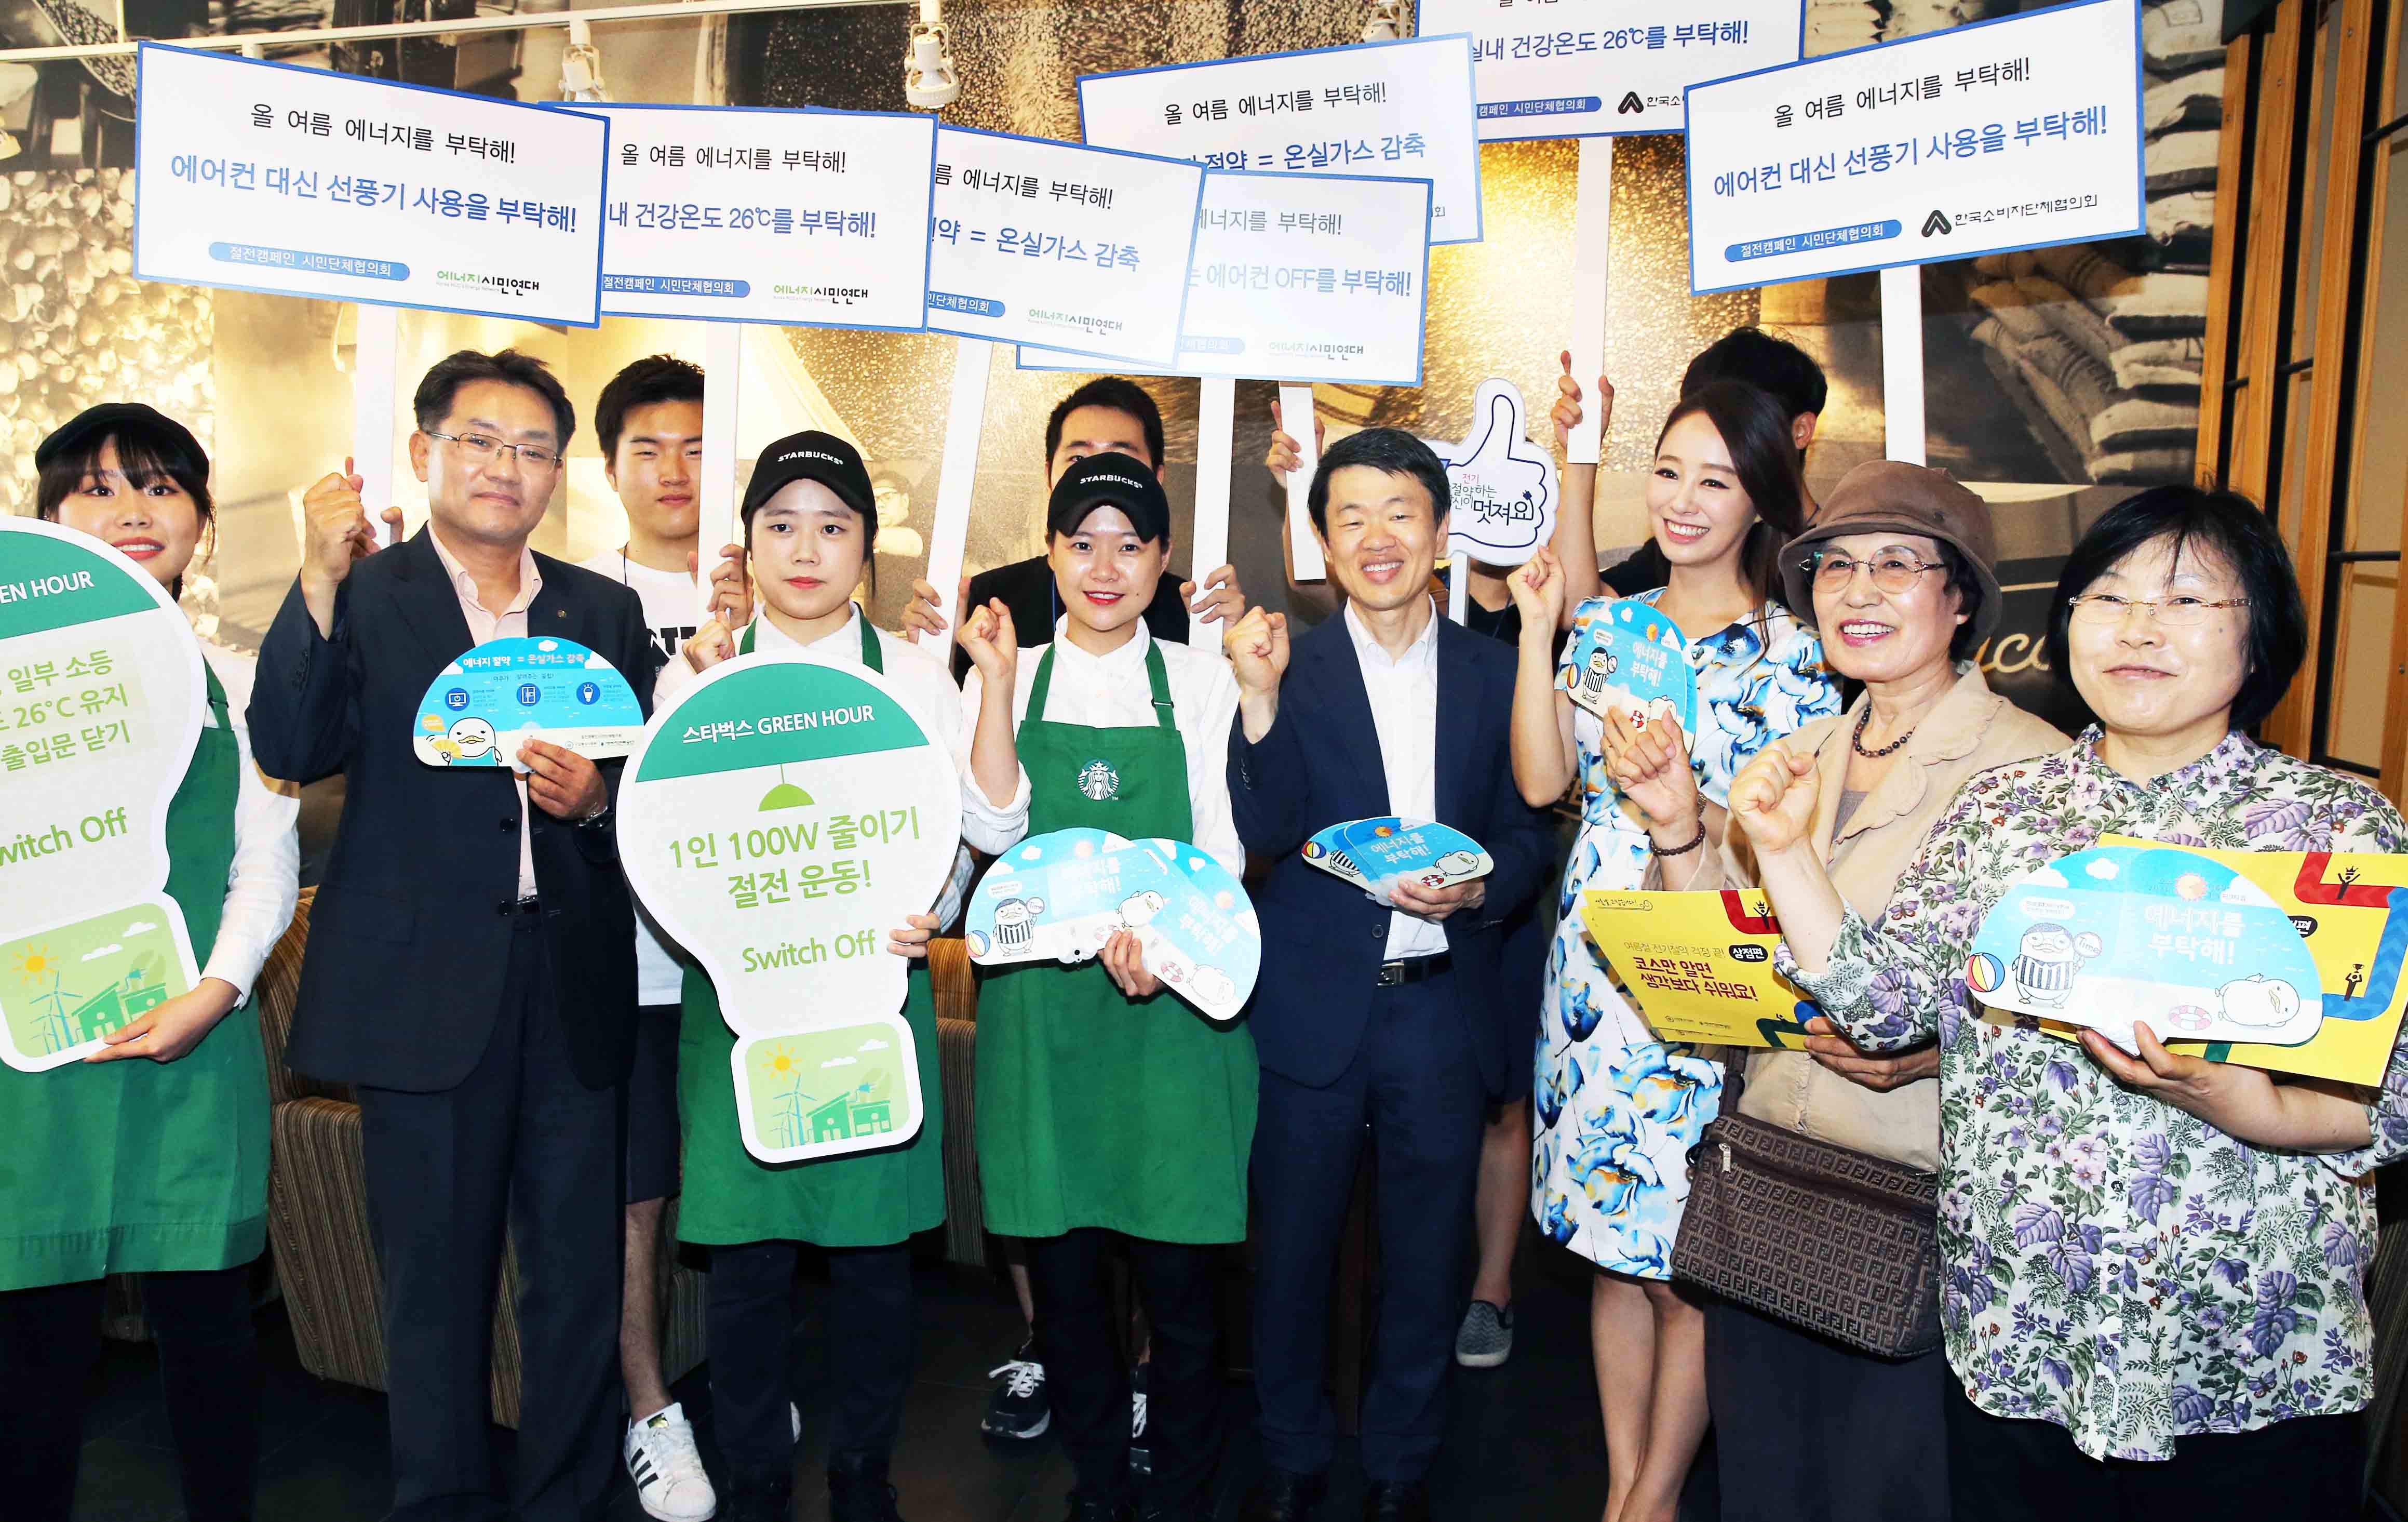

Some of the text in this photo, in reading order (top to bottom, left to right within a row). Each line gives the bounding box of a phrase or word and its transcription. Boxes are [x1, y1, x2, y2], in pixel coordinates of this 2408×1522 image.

[1512, 32, 1597, 58] 건강온도
[1673, 21, 1748, 46] 부탁해!
[1164, 82, 1387, 125] 올 여름 에너지를 부탁해!
[1479, 99, 1585, 116] 캠페인 시민단체협의회
[1774, 57, 2031, 128] 올 여름 에너지를 부탁해!
[251, 103, 516, 164] 올 여름 에너지를 부탁해!
[621, 144, 846, 173] 올 여름 에너지를 부탁해!
[1284, 139, 1377, 170] 온실가스
[1380, 132, 1427, 164] 감축
[1714, 106, 2107, 199] 에어컨 대신 선풍기 사용을 부탁해!
[171, 155, 576, 233] 에어컨 대신 선풍기 사용을 부탁해!
[935, 164, 1113, 210] 름 에너지를 부탁해!
[609, 202, 628, 227] 내
[636, 203, 723, 230] 건강온도
[800, 208, 876, 238] 부탁해!
[1278, 211, 1342, 236] 부탁해!
[1955, 194, 2098, 228] 한국소비자단체협의회
[997, 227, 1088, 261] 온실가스
[1094, 243, 1140, 272] 감축
[1741, 224, 1884, 259] 절전캠페인 시민단체협의회
[230, 245, 391, 276] 절전캠페인 시민단체협의회
[604, 276, 734, 295] 절전캠페인 시민단체협의회
[1207, 263, 1269, 289] 에어컨
[1276, 267, 1337, 294] OFF를
[1341, 270, 1411, 297] 부탁해!
[928, 293, 989, 314] 민단체협의회
[1452, 483, 1497, 498] 절약하는
[1462, 473, 1479, 484] 전기
[1473, 500, 1533, 526] 멋져요
[30, 571, 95, 598] HOUR
[8, 649, 113, 693] 일부 소등
[463, 657, 490, 668] 에너지
[492, 656, 511, 667] 절약
[79, 683, 128, 715] 유지
[682, 704, 875, 745] 스타벅스 GREEN HOUR
[1, 719, 130, 771] 출입문 닫기
[0, 807, 127, 867] witch Off
[669, 806, 920, 869] 1인 100W 줄이기
[1371, 832, 1425, 852] 에너지를
[1384, 844, 1432, 864] 부탁해!
[728, 859, 871, 909] 절전 운동!
[2145, 904, 2245, 939] 에너지를
[742, 927, 876, 972] Switch Off
[1732, 947, 1765, 959] 상점편
[2079, 936, 2100, 954] Time
[2148, 932, 2235, 965] 부탁해!
[1633, 957, 1714, 980] 코스만 알면
[1641, 973, 1758, 1002] 생각보다 쉬워요!
